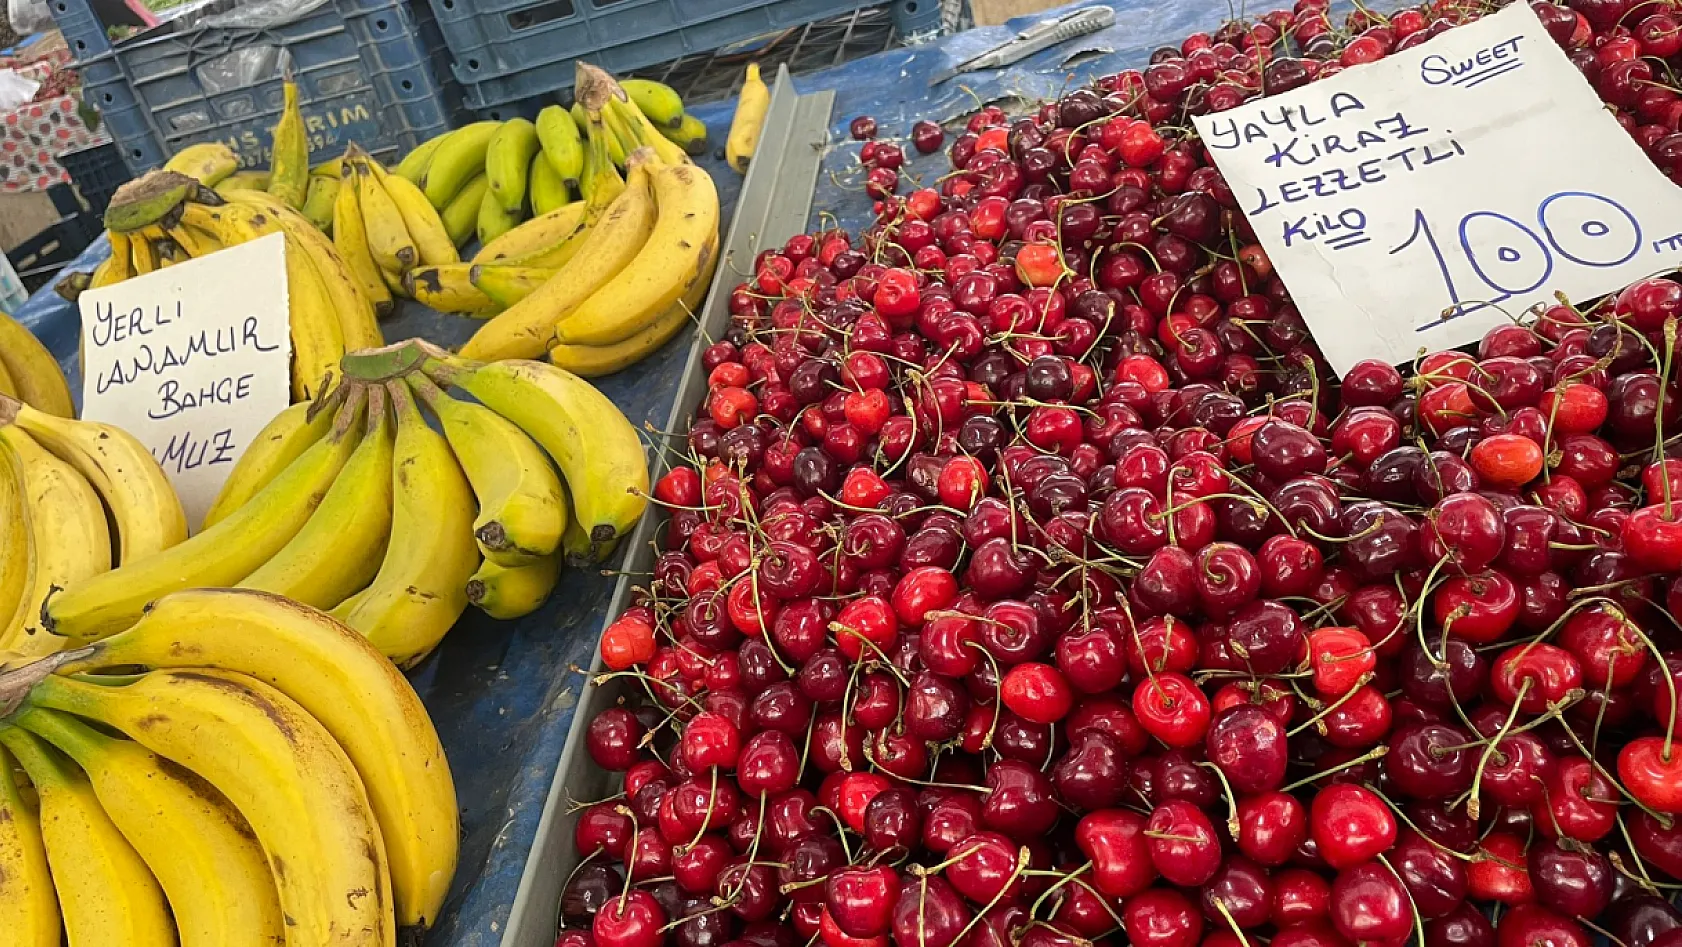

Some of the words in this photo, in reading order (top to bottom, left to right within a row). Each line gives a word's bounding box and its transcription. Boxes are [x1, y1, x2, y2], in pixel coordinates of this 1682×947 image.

[1420, 36, 1524, 85] SWEET
[1211, 93, 1364, 149] YAYLA
[1389, 191, 1642, 332] 100
[152, 429, 235, 473] MUZ
